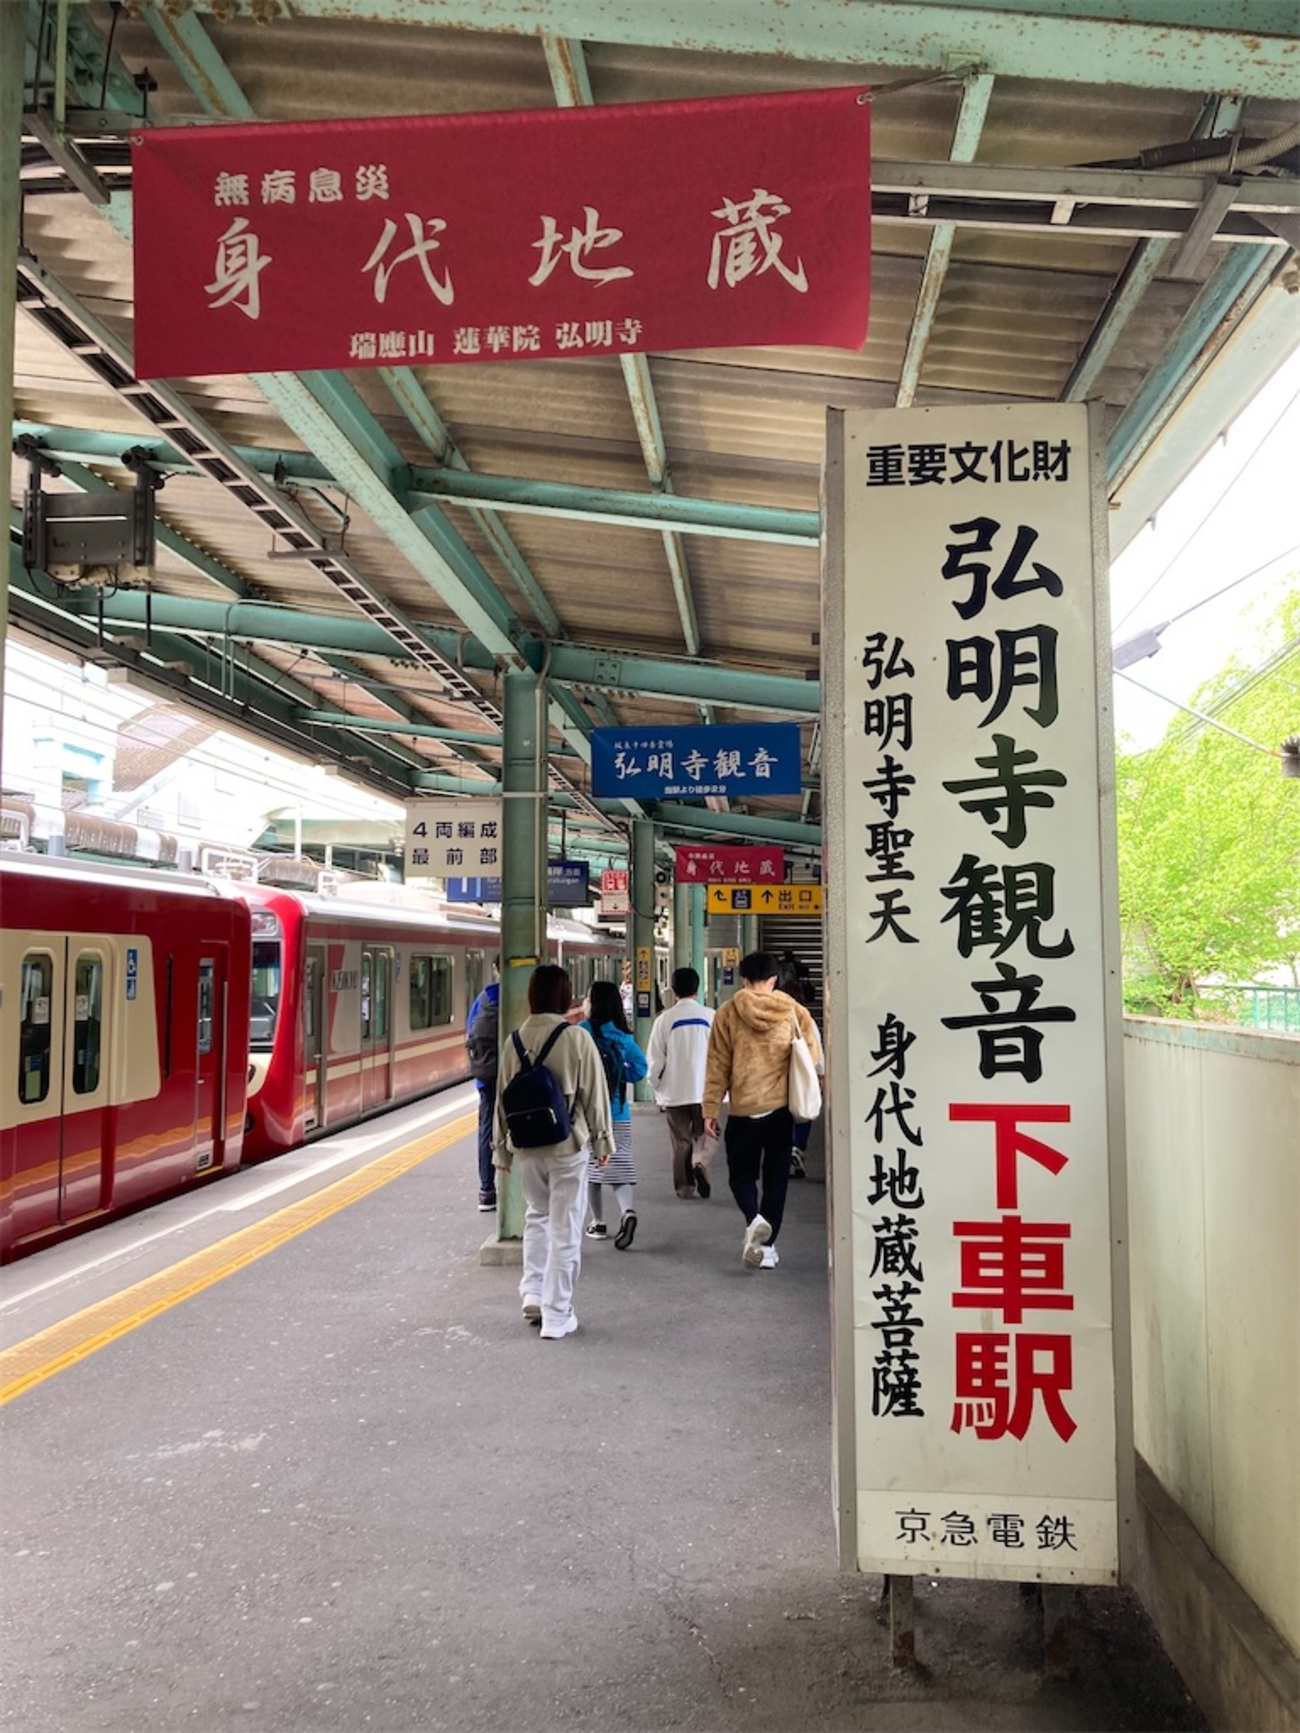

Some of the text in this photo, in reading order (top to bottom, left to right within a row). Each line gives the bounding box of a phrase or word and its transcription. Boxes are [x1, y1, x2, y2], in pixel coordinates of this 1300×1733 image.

[214, 164, 390, 207] 無病息災
[203, 188, 809, 320] 身代地蔵
[349, 317, 643, 360] 瑞應山 蓮華院 弘明寺
[866, 440, 1071, 487] 重要文化財
[613, 747, 779, 781] 弘明寺観音
[412, 821, 498, 839] 4両編成
[412, 848, 498, 866] 最前部
[685, 858, 776, 877] 身代地蔵
[778, 889, 812, 902] 出口
[861, 631, 925, 1418] 弘明寺聖天 身代地蔵菩薩
[895, 1507, 1078, 1552] 京急電鉄
